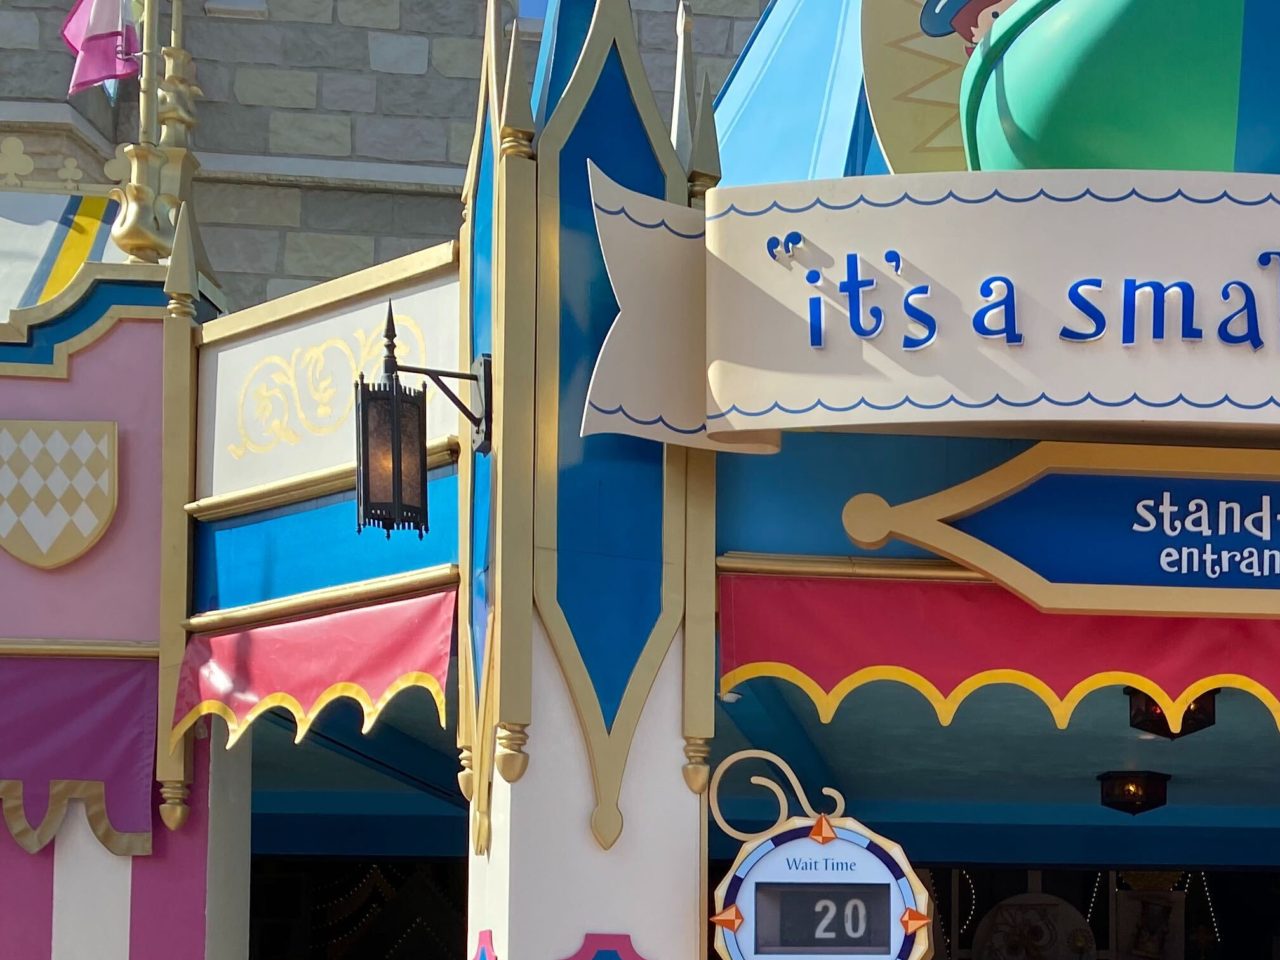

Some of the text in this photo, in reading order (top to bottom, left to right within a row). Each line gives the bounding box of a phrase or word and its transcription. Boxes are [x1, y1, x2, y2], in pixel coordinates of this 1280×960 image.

[972, 275, 1024, 346] a
[786, 857, 857, 872] Wait Time
[814, 898, 867, 939] 20
